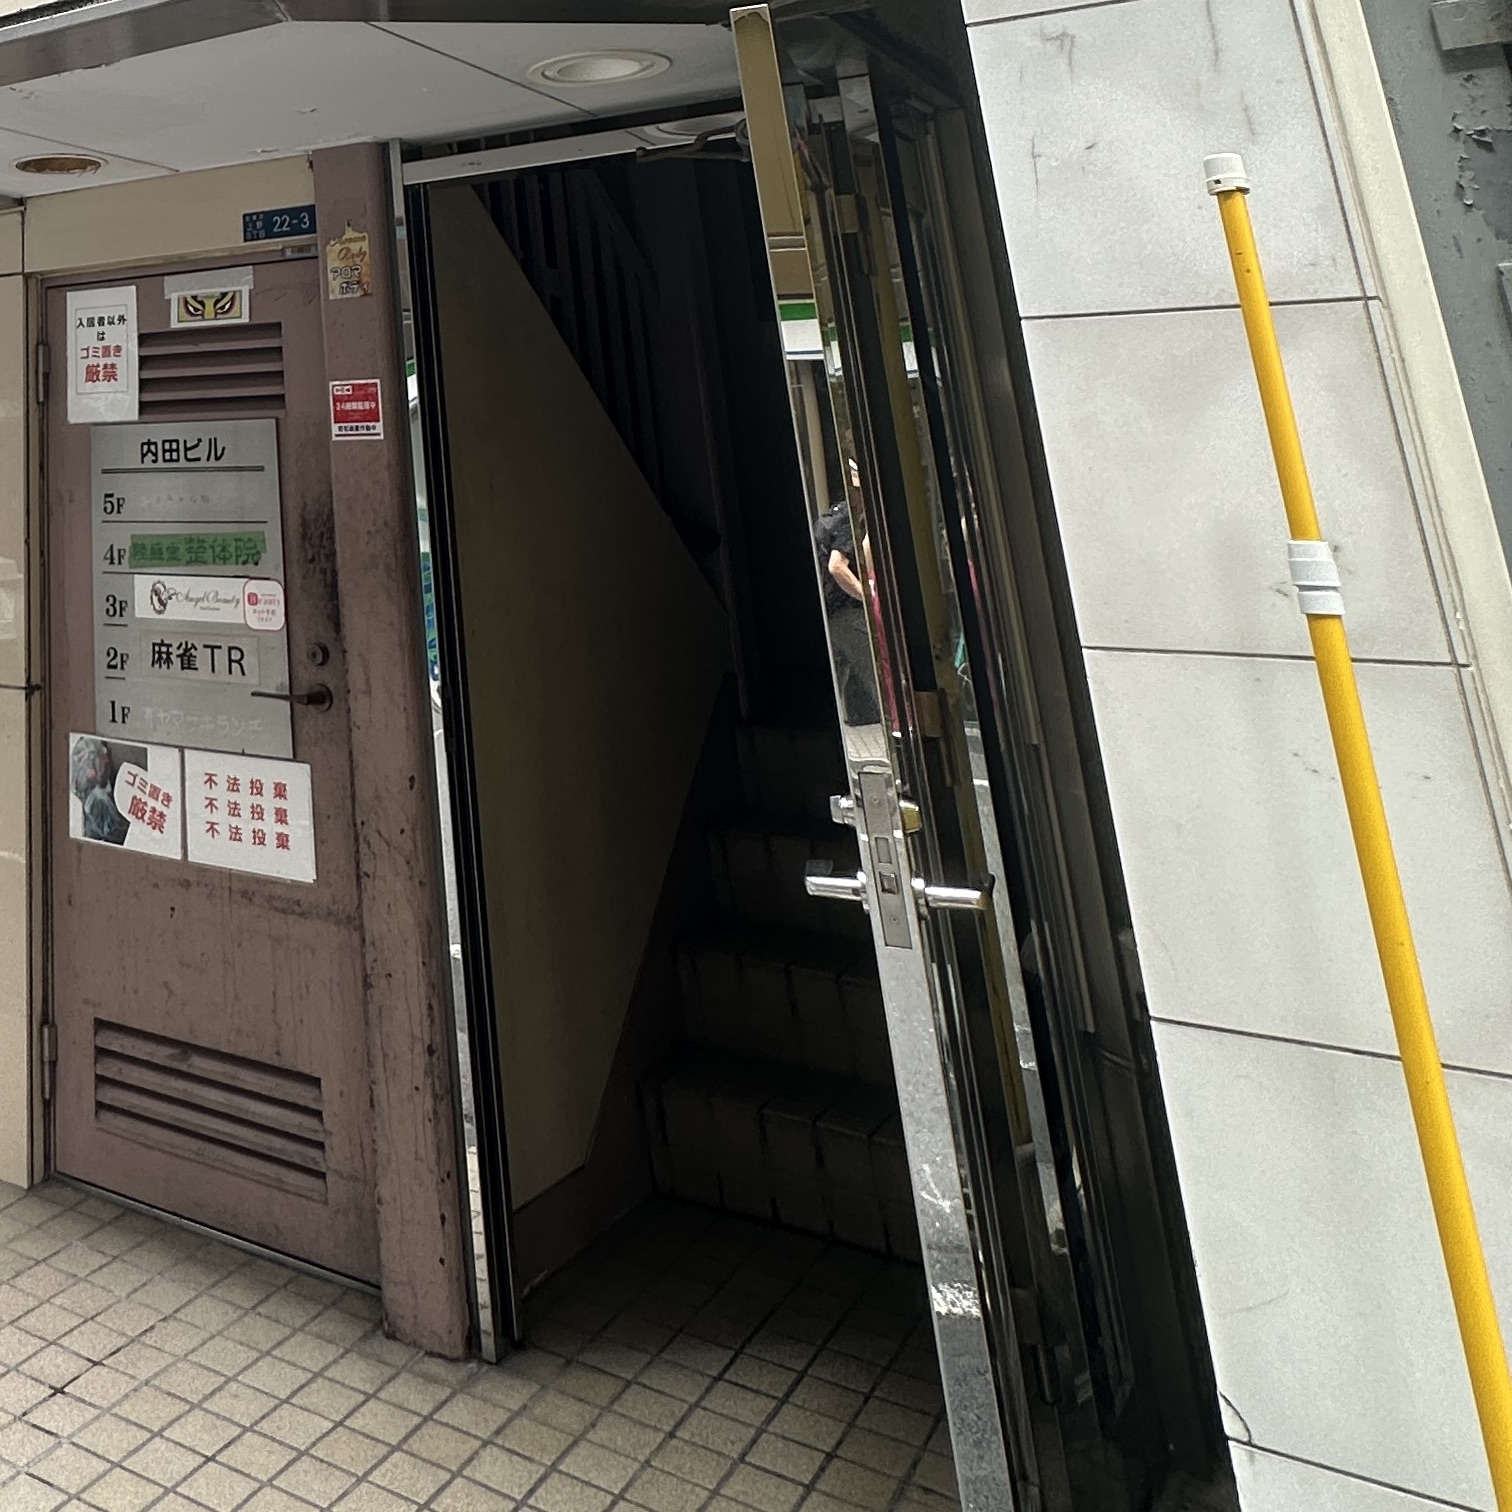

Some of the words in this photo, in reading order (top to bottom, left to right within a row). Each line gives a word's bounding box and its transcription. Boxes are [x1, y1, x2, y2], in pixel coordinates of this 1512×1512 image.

[272, 212, 310, 233] 22-3
[76, 314, 127, 329] 入居者以外
[96, 330, 106, 342] は
[80, 344, 123, 360] ゴミ置き
[84, 361, 119, 383] 厳禁
[140, 436, 226, 465] 内田ビル
[102, 492, 126, 515] 5F
[103, 543, 127, 566] 4F
[105, 594, 128, 618] 3F
[106, 646, 130, 671] 2F
[150, 638, 247, 677] 麻雀TR
[108, 700, 131, 725] 1F
[124, 770, 174, 810] ゴミ置き
[203, 771, 289, 802] 不法投棄
[127, 794, 168, 835] 厳禁
[204, 796, 290, 827] 不法投棄
[205, 820, 291, 851] 不法投棄
